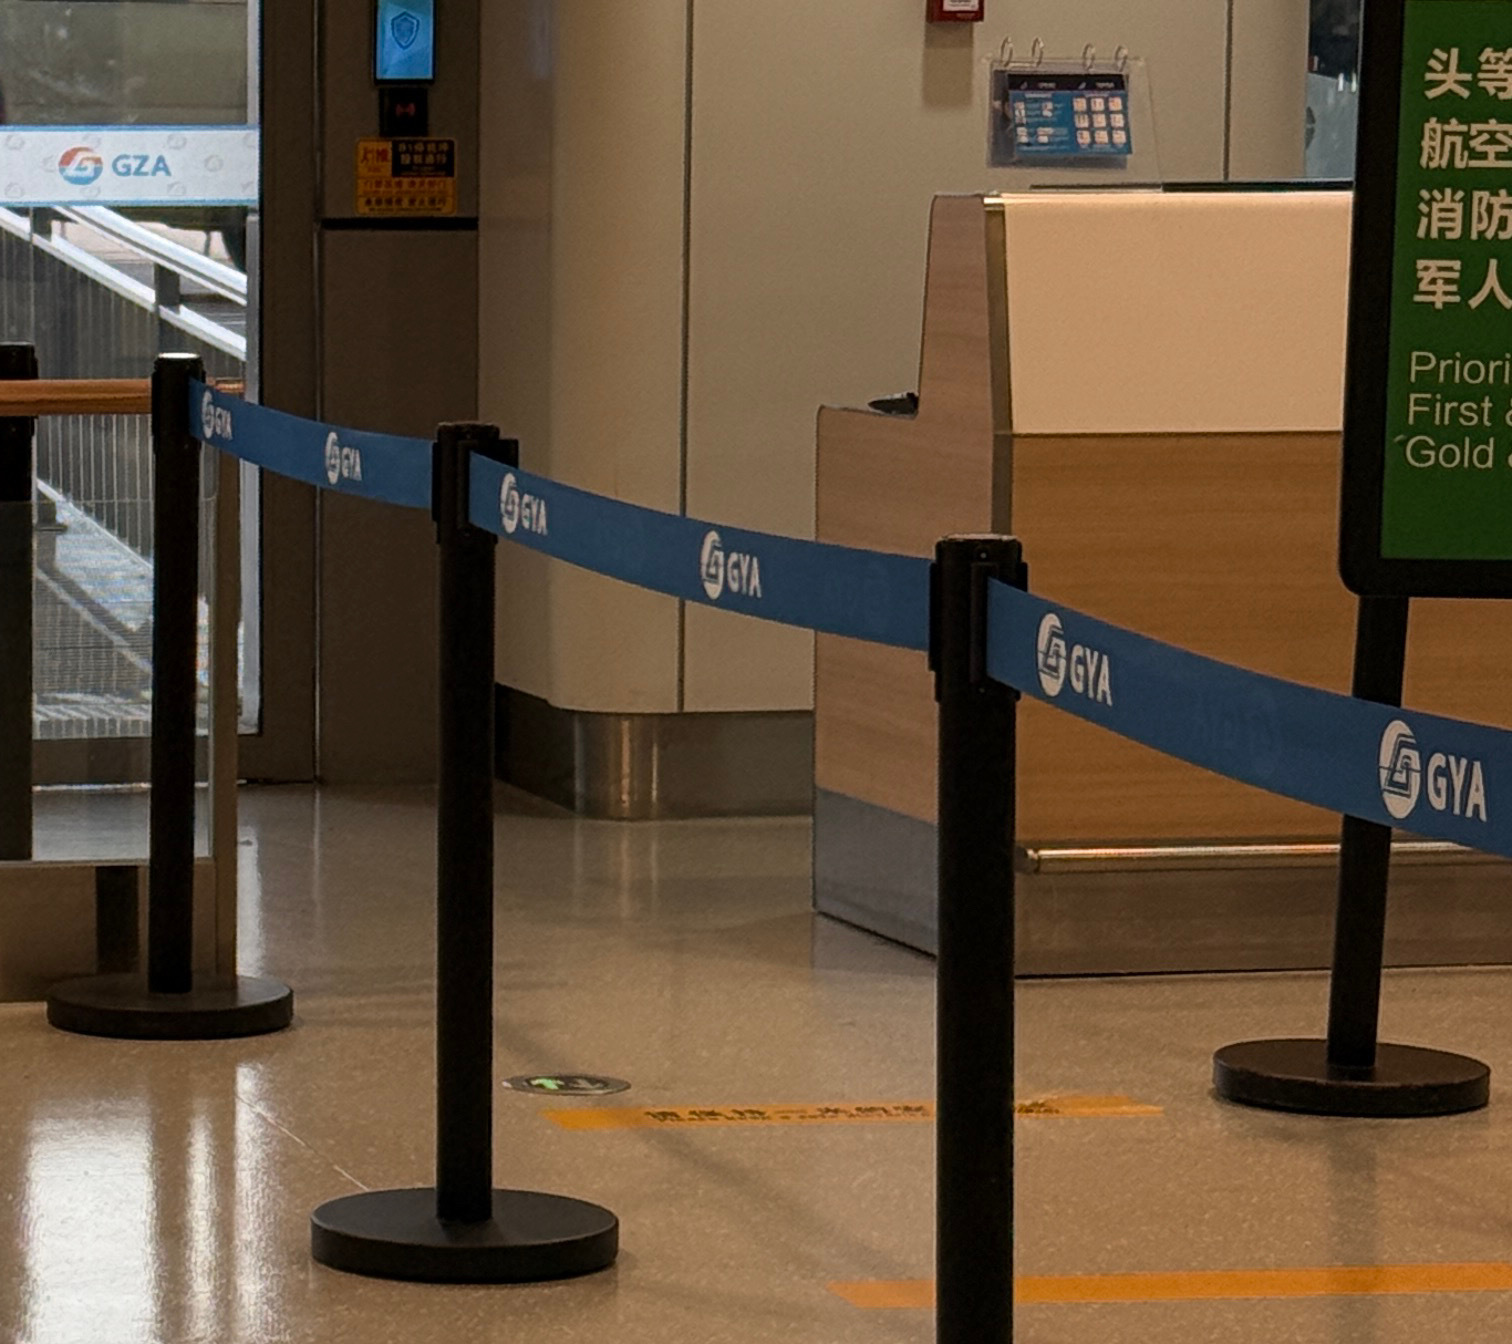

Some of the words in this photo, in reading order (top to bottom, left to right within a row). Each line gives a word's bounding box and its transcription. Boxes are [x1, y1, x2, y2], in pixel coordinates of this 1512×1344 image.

[111, 154, 172, 177] GZA
[1419, 117, 1512, 169] 航空
[1416, 187, 1512, 240] 消防
[1413, 258, 1512, 310] 军人
[1408, 393, 1493, 426] First
[1405, 435, 1494, 468] Gold
[521, 493, 548, 536] GYA
[727, 552, 762, 598] GYA
[1070, 644, 1113, 706] GYA
[1428, 752, 1487, 822] GYA
